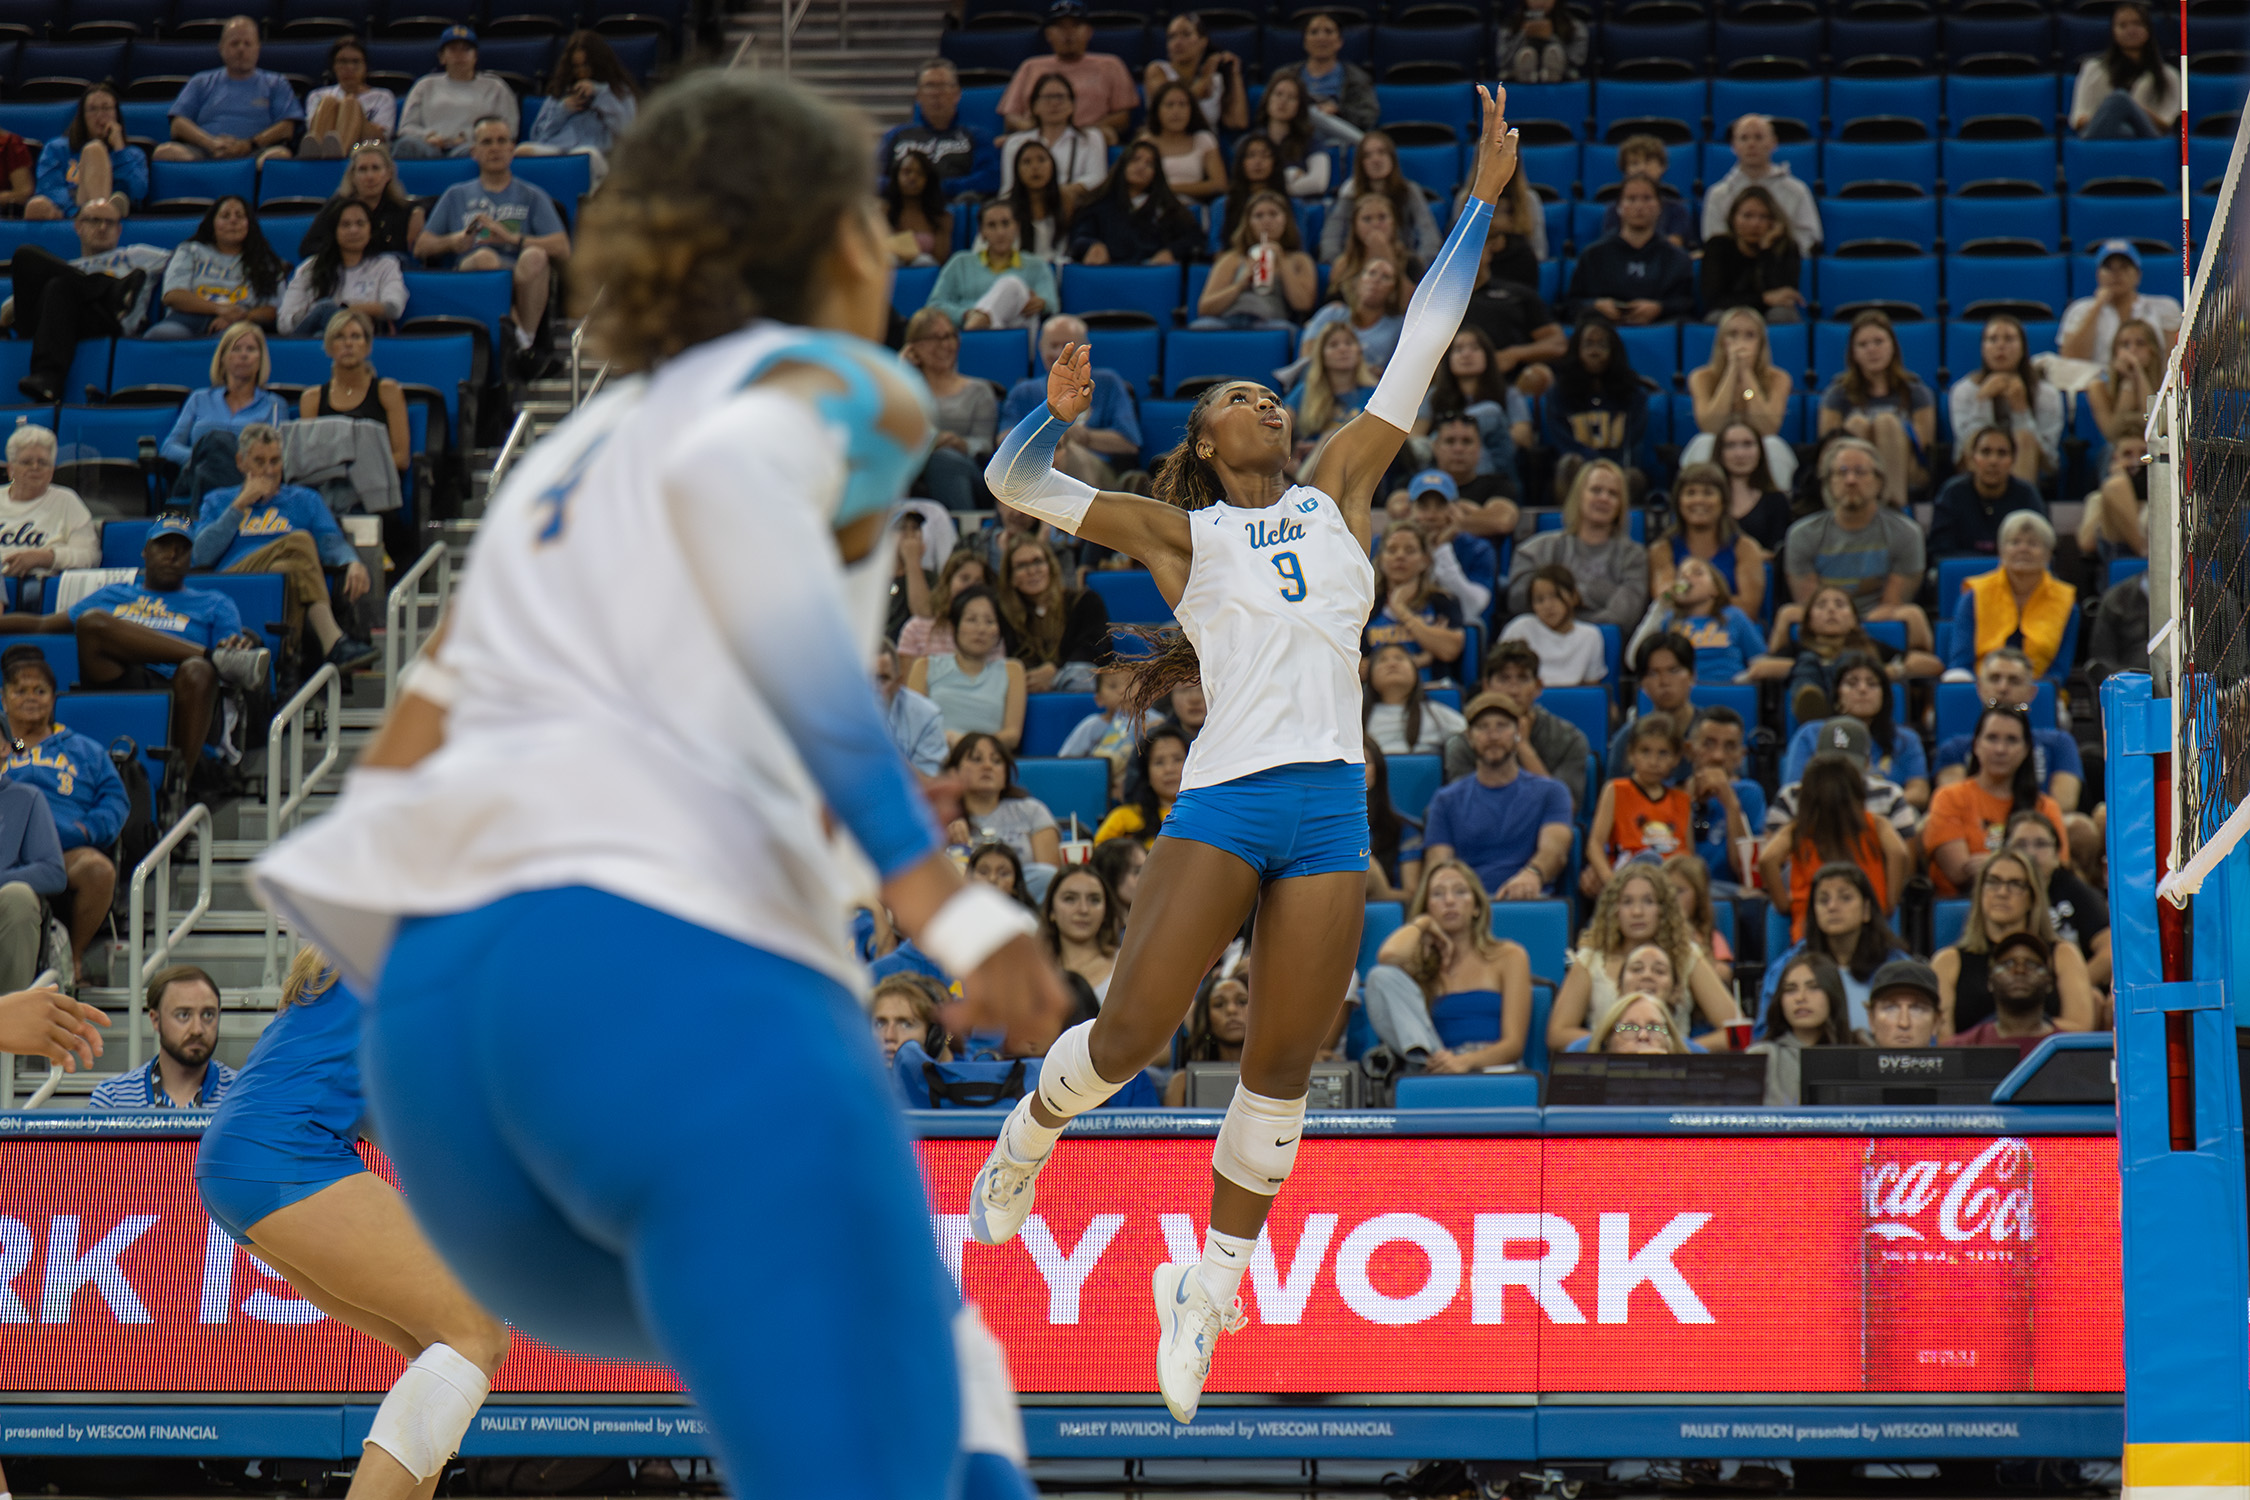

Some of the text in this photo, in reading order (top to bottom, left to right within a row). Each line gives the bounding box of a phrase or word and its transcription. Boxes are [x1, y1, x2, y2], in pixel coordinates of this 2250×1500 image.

[0, 522, 48, 548] cla
[1245, 518, 1307, 549] Ucla
[1270, 550, 1308, 603] 9
[25, 1116, 84, 1132] presented
[88, 1116, 101, 1133] by
[105, 1116, 164, 1130] WESCOM
[1065, 1117, 1111, 1131] PAULEY
[1114, 1116, 1174, 1130] PAVILION
[1157, 1212, 1716, 1325] WORK
[5, 1424, 218, 1442] presented by WESCOM FINANCIAL
[481, 1417, 527, 1431] PAULEY
[531, 1417, 589, 1431] PAVILION
[593, 1418, 653, 1434] presented
[657, 1418, 673, 1436] by
[1060, 1421, 1393, 1440] PAULEY PAVILION presented by WESCOM FINANCIAL
[1680, 1423, 2019, 1442] PAULEY PAVILION presented by WESCOM FINANCIAL
